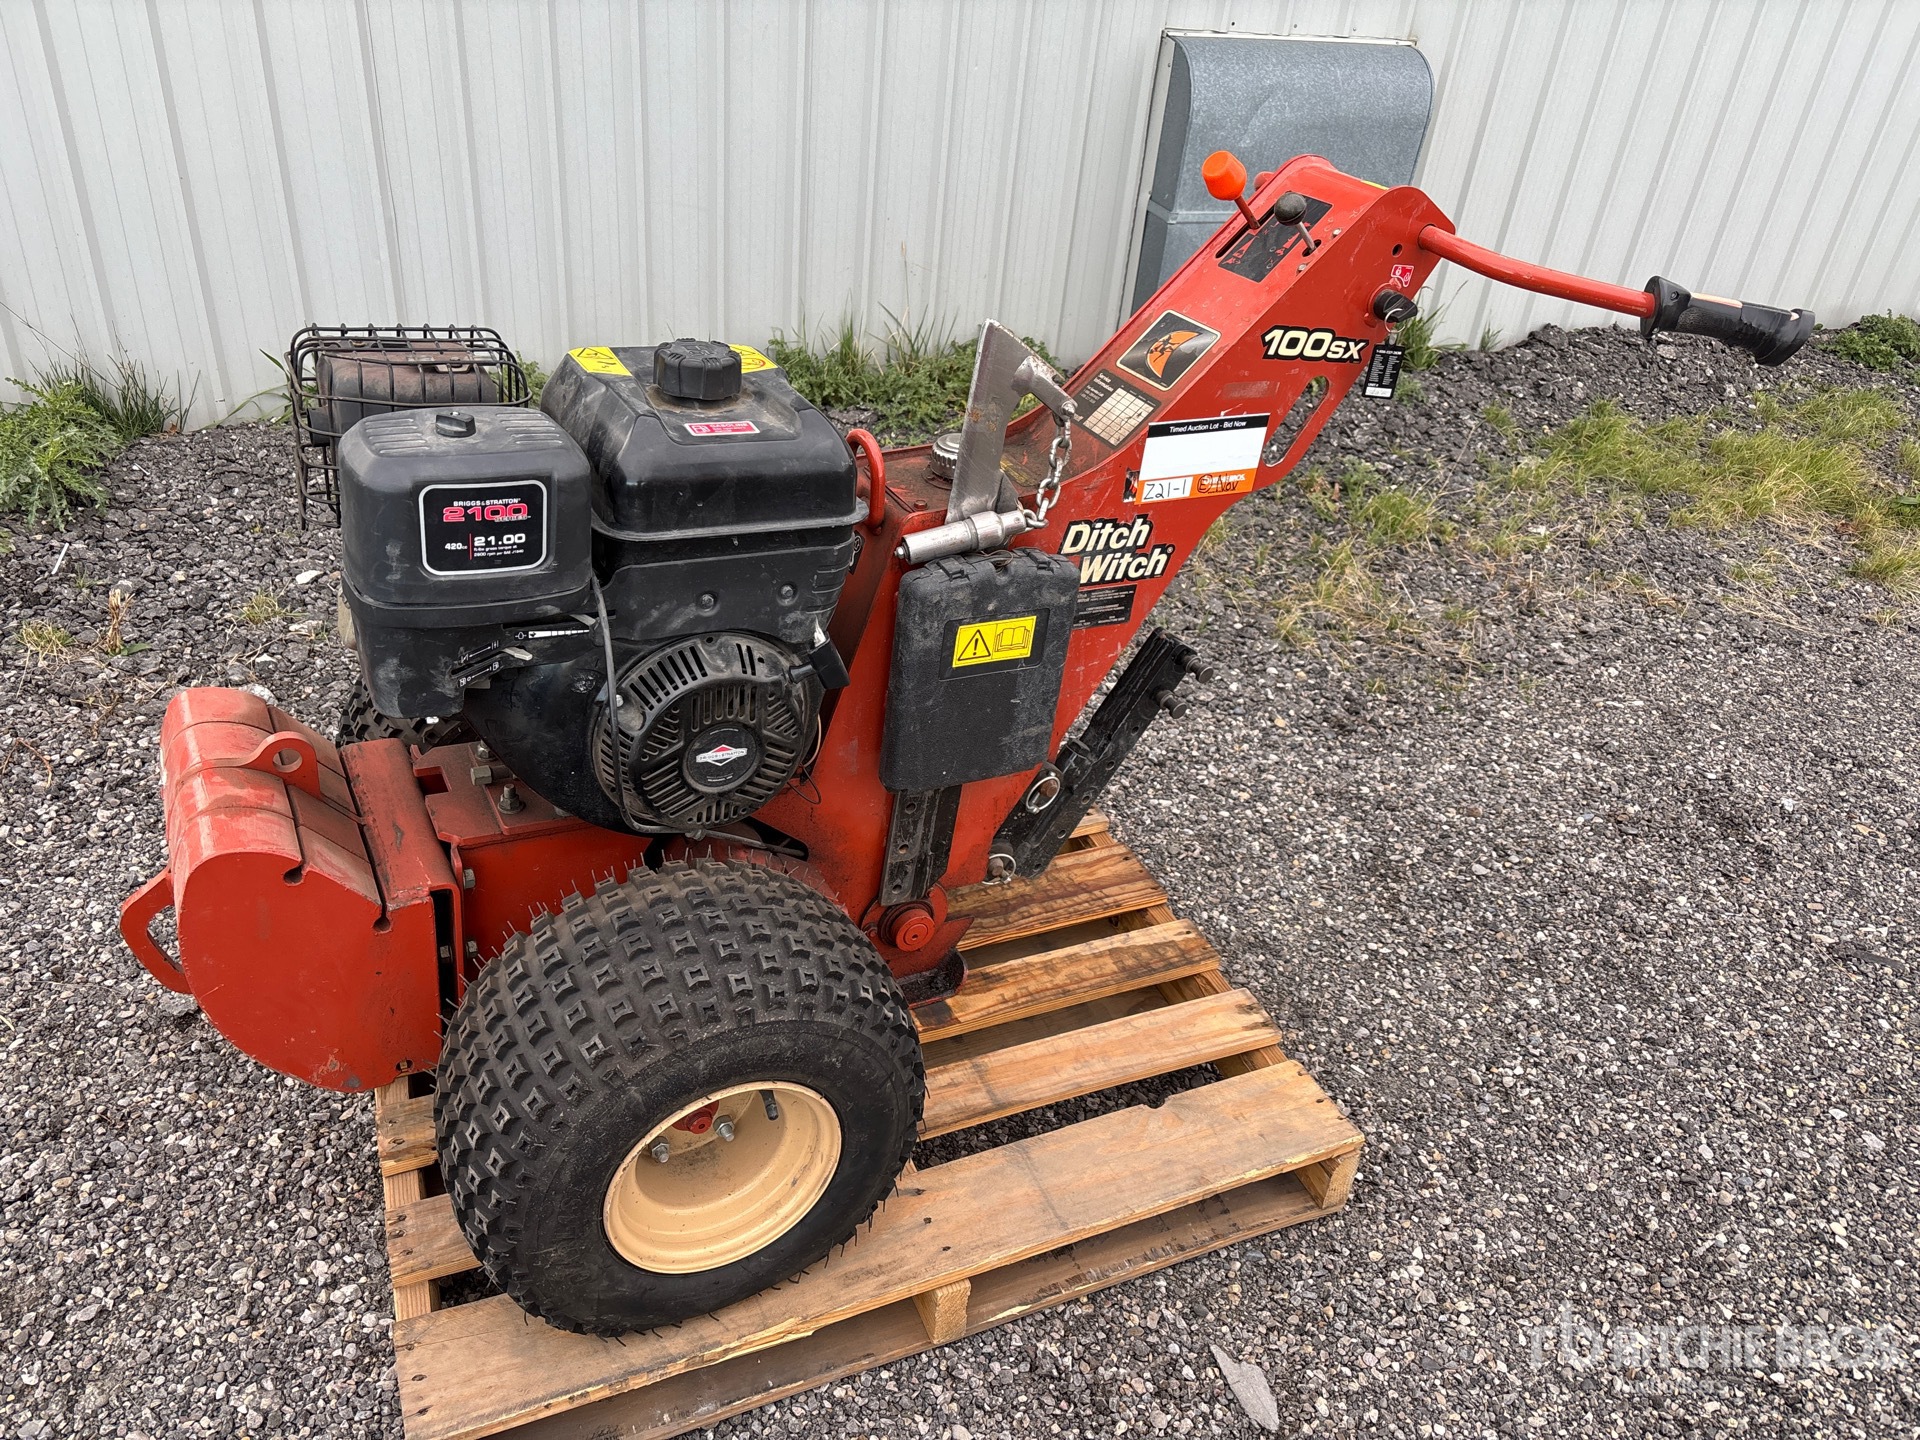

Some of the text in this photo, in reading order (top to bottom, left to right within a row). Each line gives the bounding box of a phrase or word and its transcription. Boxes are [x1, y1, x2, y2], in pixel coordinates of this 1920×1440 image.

[1187, 424, 1209, 432] Auction
[443, 503, 528, 522] 2100
[474, 533, 526, 546] 21.00
[1060, 518, 1150, 554] Ditch
